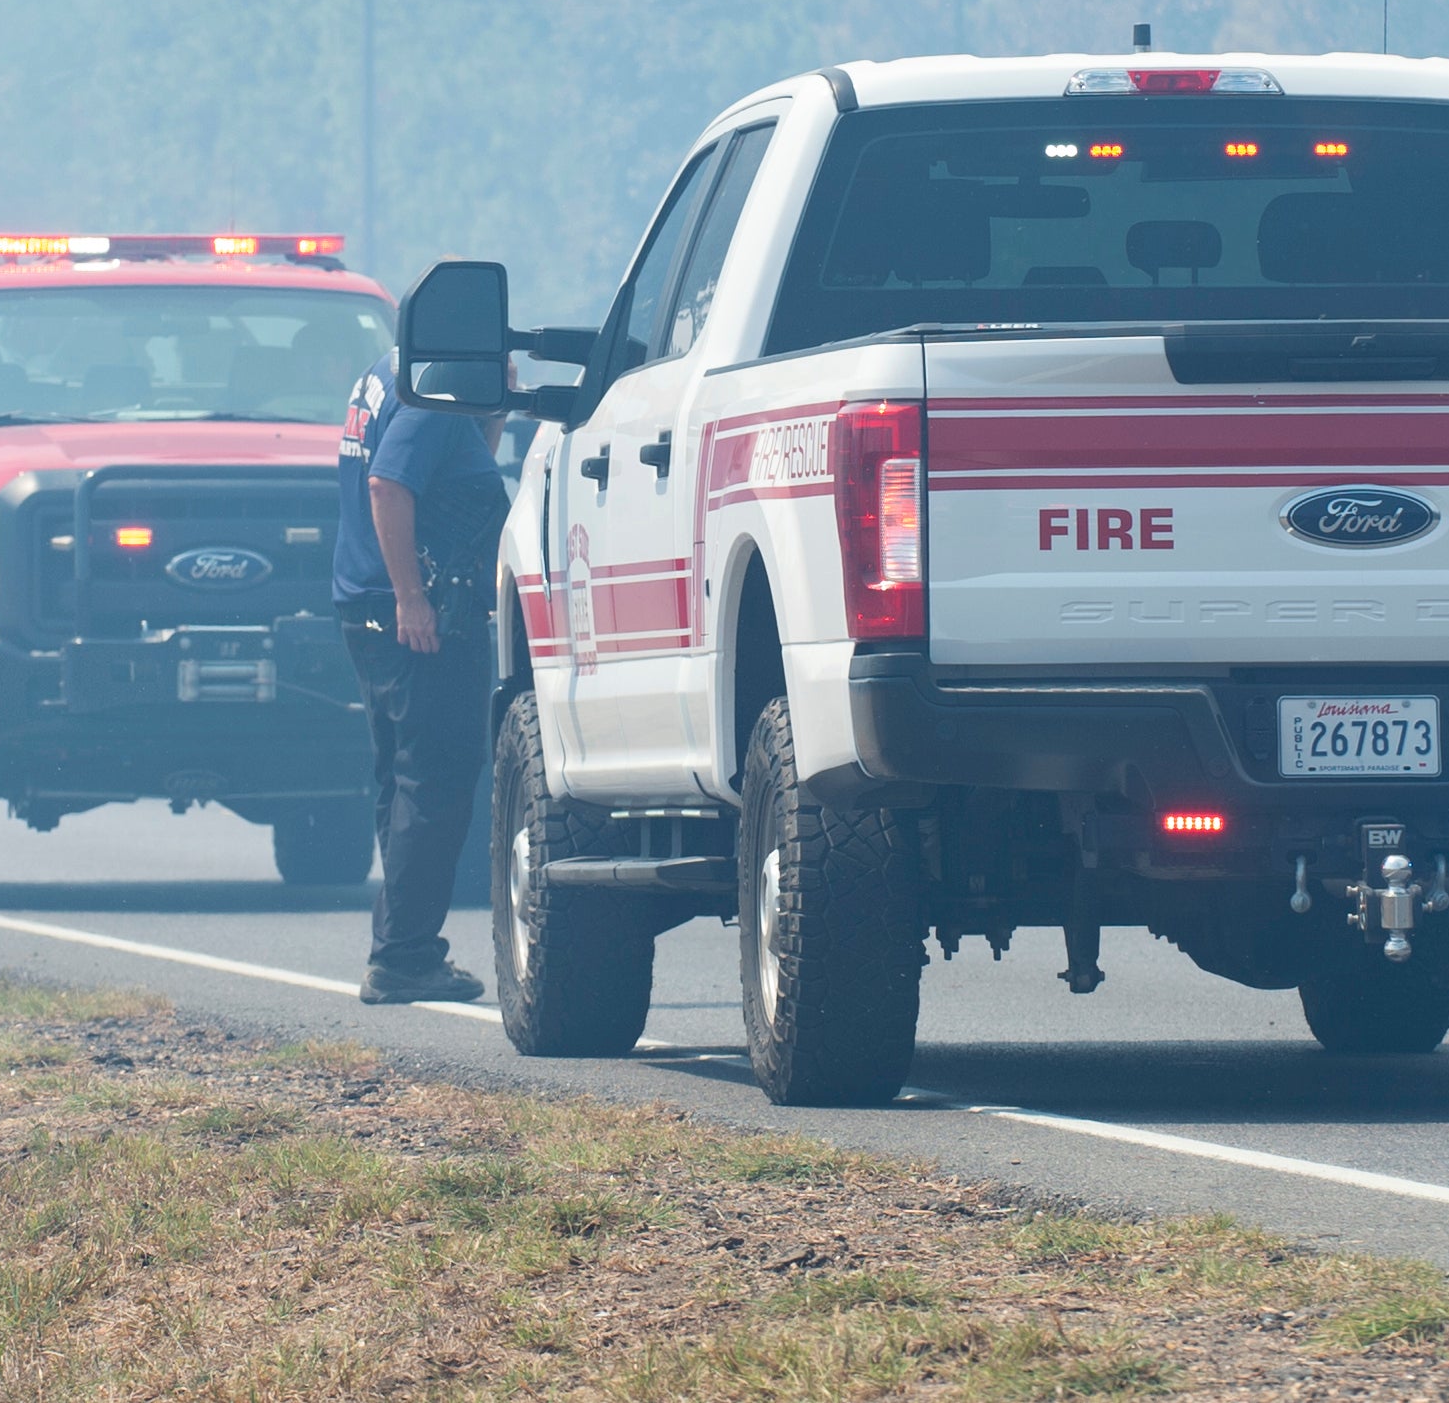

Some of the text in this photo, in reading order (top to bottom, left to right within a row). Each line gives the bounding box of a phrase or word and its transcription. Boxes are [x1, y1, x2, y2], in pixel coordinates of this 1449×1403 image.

[1038, 508, 1175, 551] FIRE
[1318, 497, 1403, 534] Ford
[190, 554, 249, 579] Ford
[1059, 600, 1387, 624] SUPER
[1316, 701, 1399, 718] Louisiana
[1294, 717, 1304, 768] PUBLIC
[1310, 719, 1432, 757] 267873
